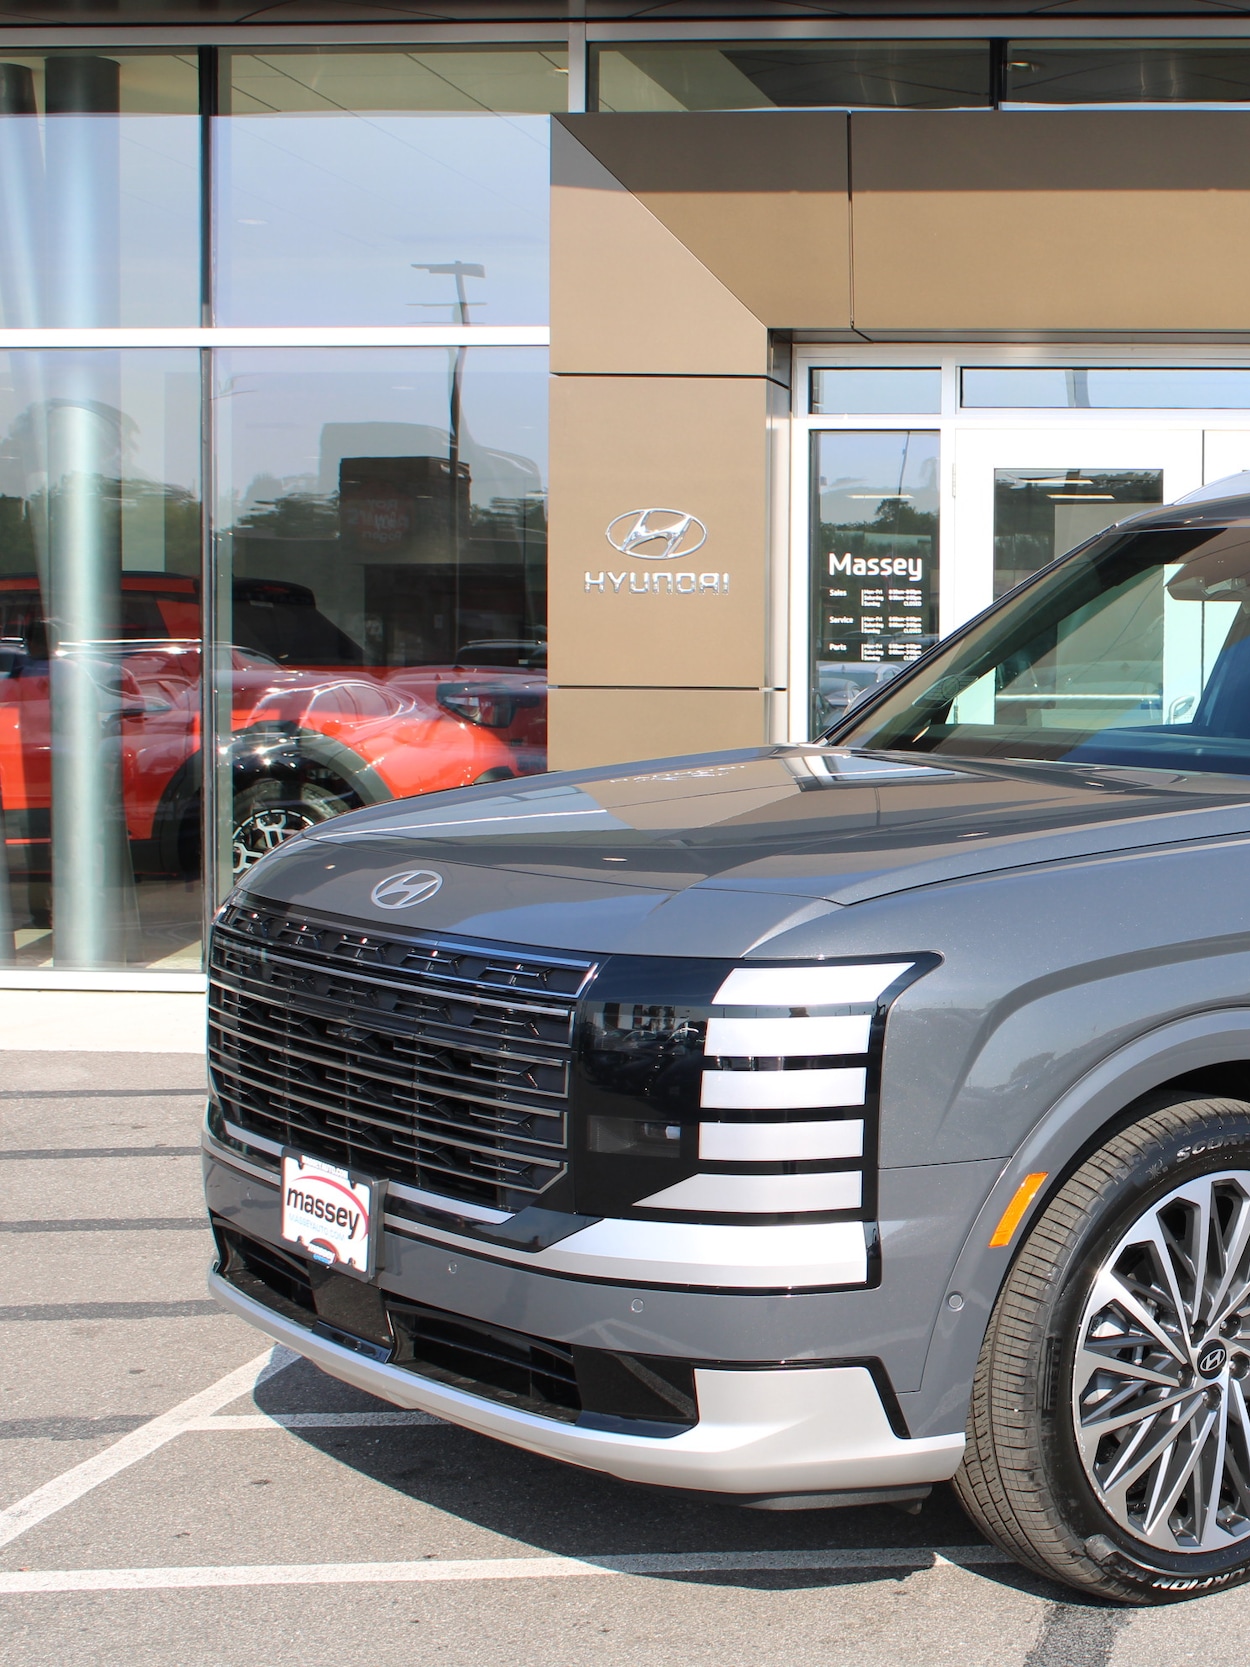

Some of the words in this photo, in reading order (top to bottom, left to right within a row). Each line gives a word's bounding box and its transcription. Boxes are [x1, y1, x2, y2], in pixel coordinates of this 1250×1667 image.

[828, 553, 922, 581] Massey
[584, 570, 730, 595] HYUNDAI
[829, 589, 847, 597] Sales
[829, 616, 854, 624] Service
[286, 1187, 361, 1240] massey
